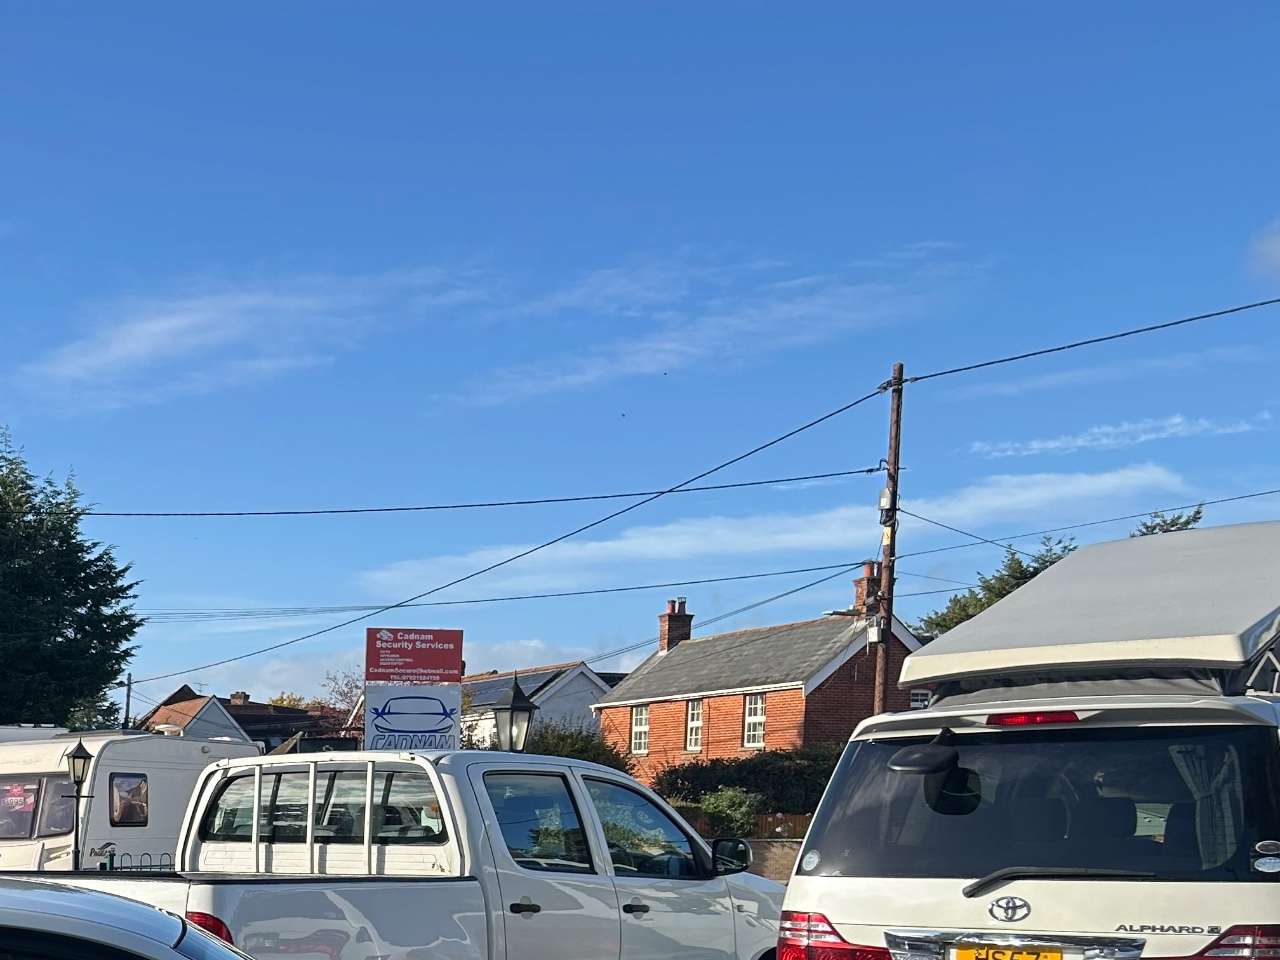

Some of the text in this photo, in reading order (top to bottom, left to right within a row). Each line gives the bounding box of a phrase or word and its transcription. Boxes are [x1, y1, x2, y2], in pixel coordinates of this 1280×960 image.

[397, 632, 433, 640] Cadnam
[376, 640, 454, 650] Security Services
[370, 734, 456, 750] CADNAM
[1115, 924, 1205, 934] ALPHARD
